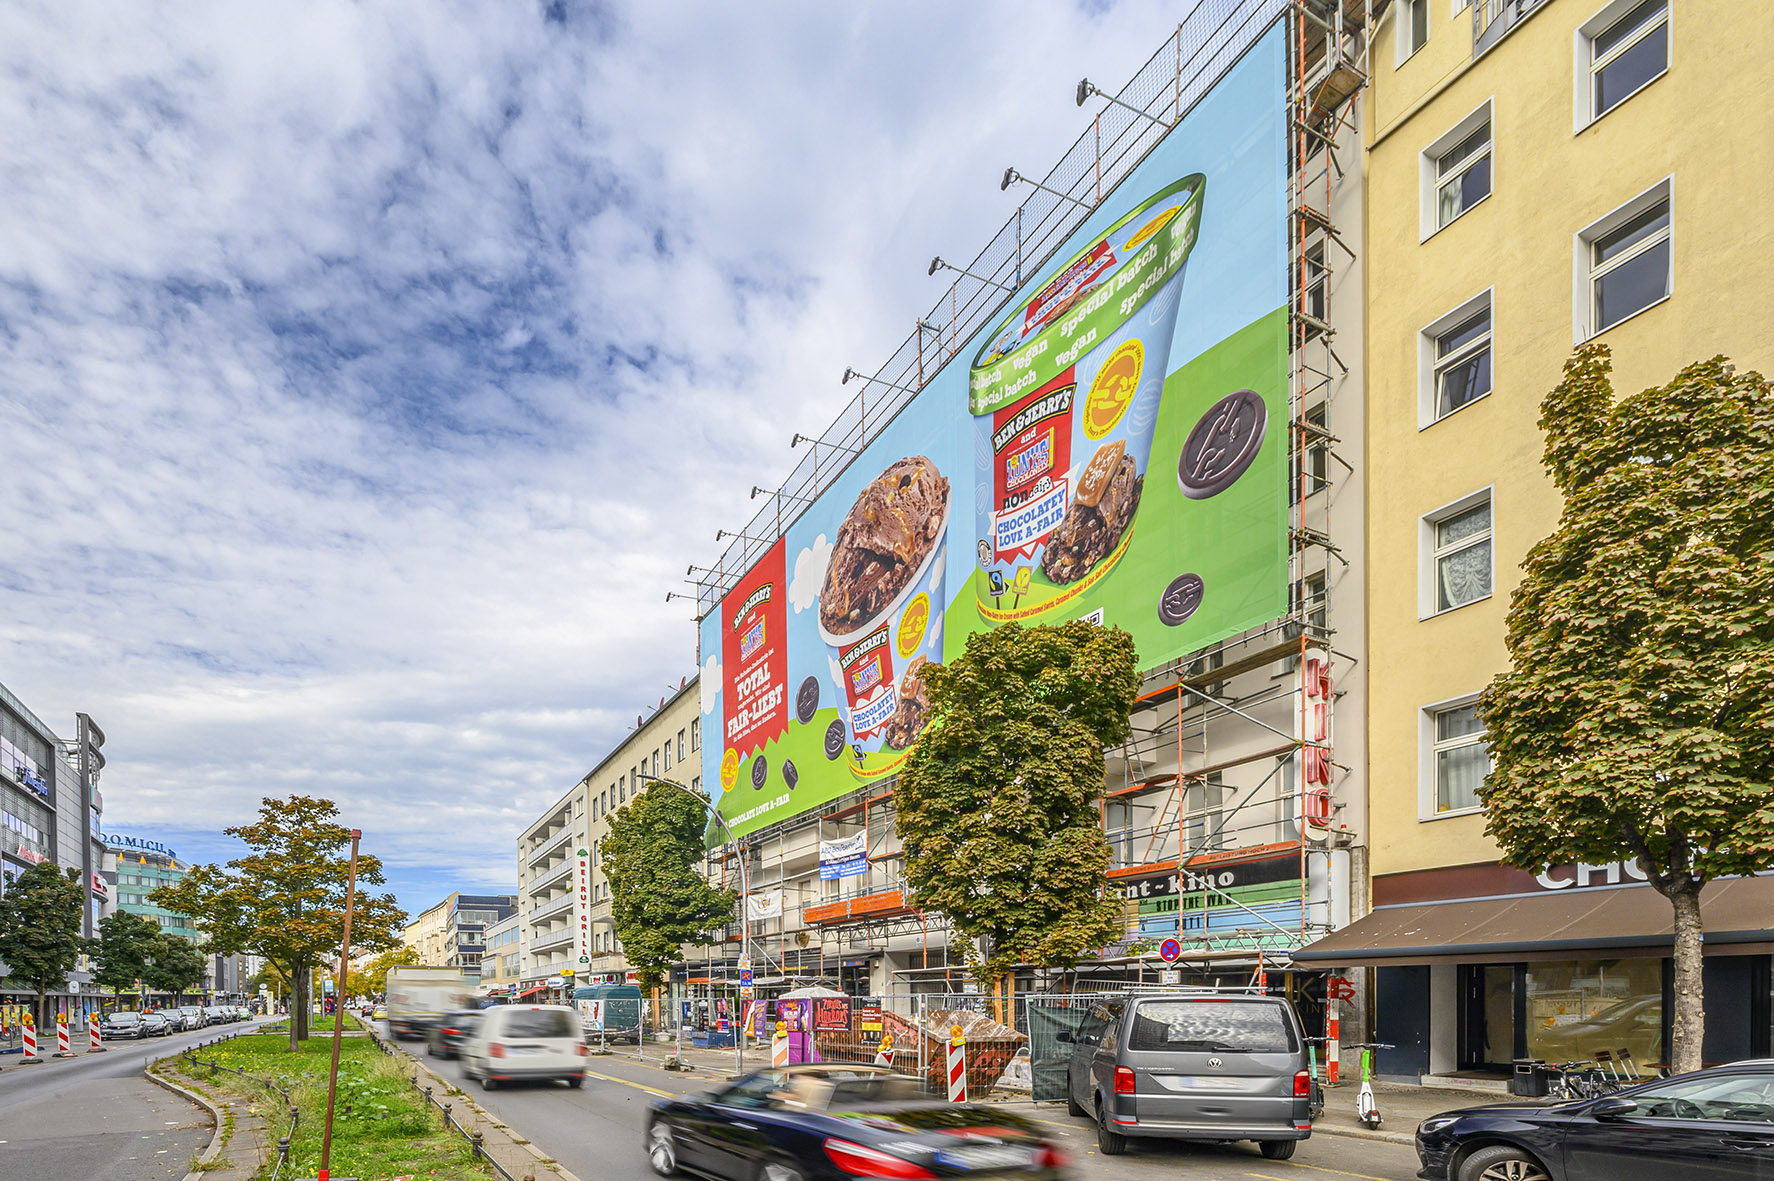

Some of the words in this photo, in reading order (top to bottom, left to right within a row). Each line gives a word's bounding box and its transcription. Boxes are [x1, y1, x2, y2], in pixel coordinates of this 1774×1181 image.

[1061, 280, 1115, 337] special
[1116, 243, 1158, 291] batch
[1120, 256, 1169, 316] special
[1013, 339, 1048, 370] vegan
[1055, 328, 1097, 367] vegan
[1004, 369, 1037, 398] batch
[1020, 426, 1037, 444] and
[997, 488, 1066, 534] CHOCOLATEY
[999, 529, 1023, 547] LOVE
[1025, 507, 1064, 538] A-FAIR
[736, 662, 771, 702] TOTAL
[727, 683, 783, 739] FAIR-LIEBT
[852, 691, 894, 722] CHOCOLATEY
[855, 717, 873, 730] LOVE
[871, 703, 895, 724] A-FAIR
[1156, 898, 1180, 912] STOP
[1182, 896, 1200, 910] THE
[580, 915, 588, 956] GRILL
